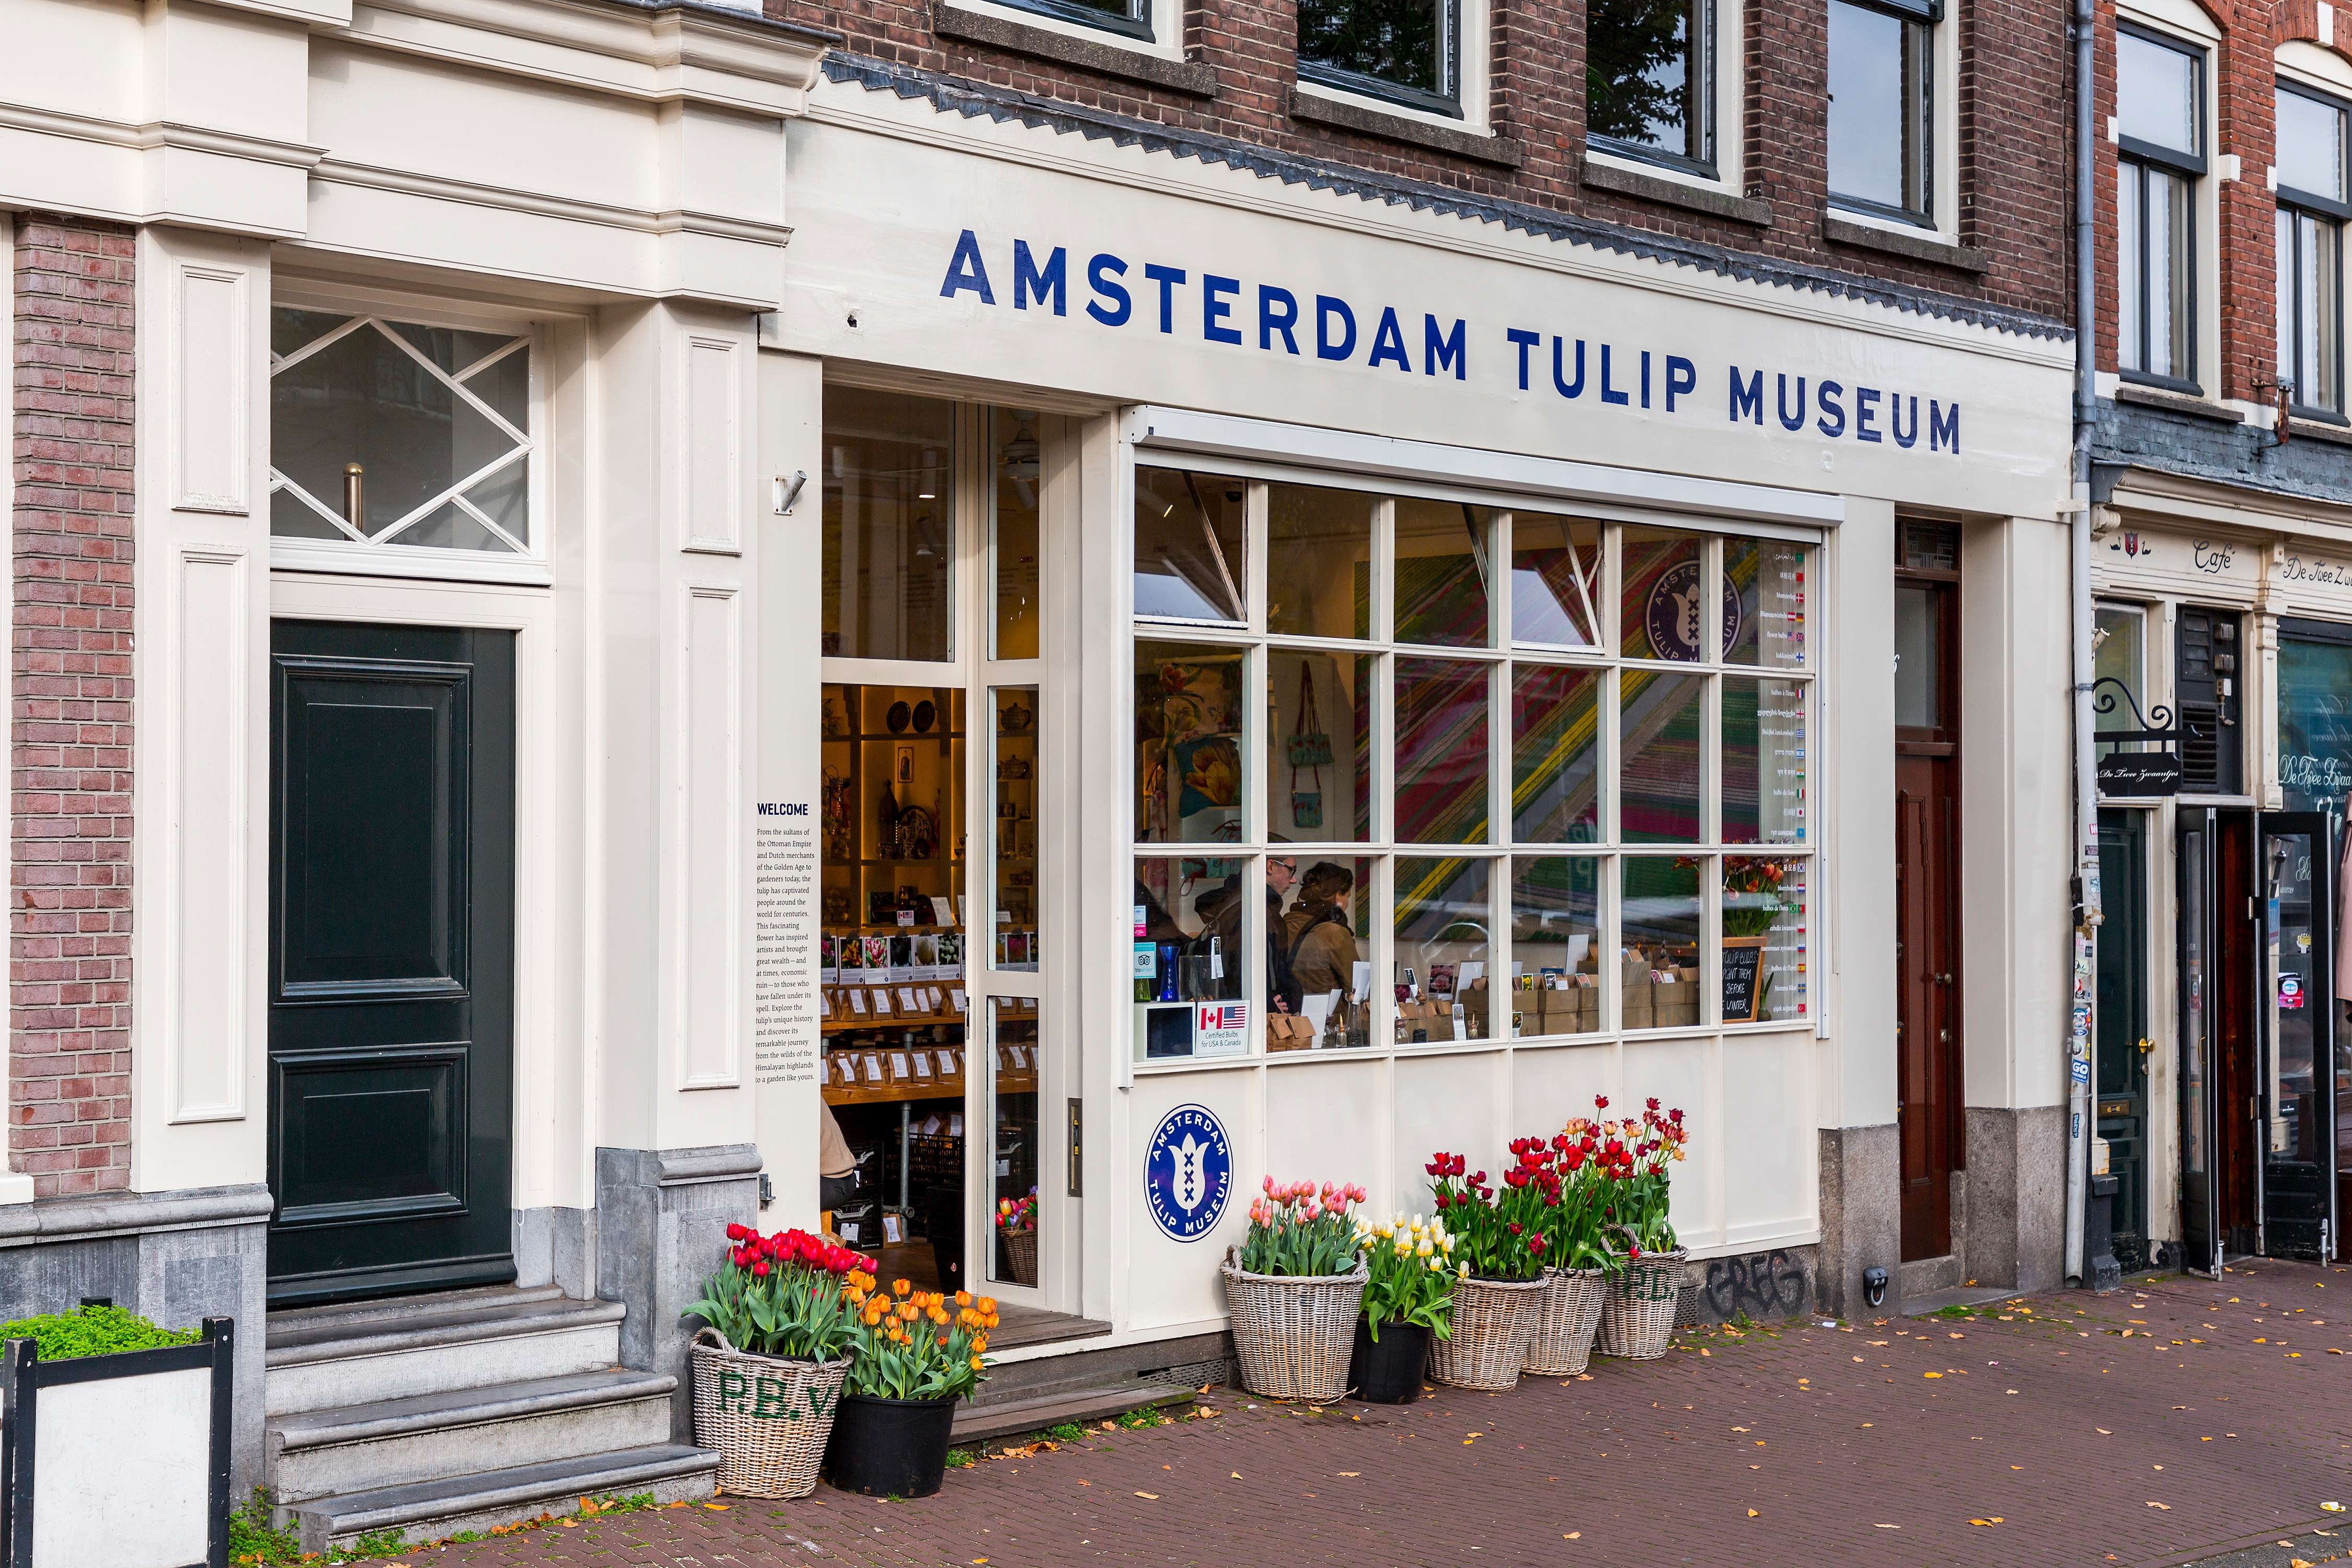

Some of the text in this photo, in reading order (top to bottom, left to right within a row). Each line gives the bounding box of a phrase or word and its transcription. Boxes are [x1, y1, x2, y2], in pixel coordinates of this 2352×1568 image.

[941, 230, 1959, 454] AMSTERDAM TULIP MUSEUM
[2193, 538, 2236, 574] Café
[2283, 555, 2306, 580] De
[2309, 559, 2333, 583] Twee
[1656, 567, 1733, 606] AMSTEM
[1652, 620, 1679, 660] TULIP
[2099, 769, 2114, 778] De
[2114, 767, 2137, 778] Twee
[2279, 755, 2298, 785] De
[2298, 756, 2322, 795] Twee
[757, 803, 808, 815] WELCOME
[757, 875, 783, 884] gardeners
[757, 899, 775, 907] people
[787, 933, 808, 942] inspired
[1739, 968, 1752, 981] THEM
[1726, 983, 1745, 995] BEFORE
[756, 1005, 770, 1013] spell.
[772, 1004, 792, 1012] Explore
[1726, 998, 1749, 1013] WINTER
[1205, 1031, 1225, 1039] Certified
[1224, 1039, 1242, 1047] Canada
[787, 1062, 814, 1070] highlands
[767, 1075, 786, 1084] garden
[1152, 1112, 1226, 1162] AMSTERDAM
[1150, 1171, 1228, 1233] TULIP MUSEUM
